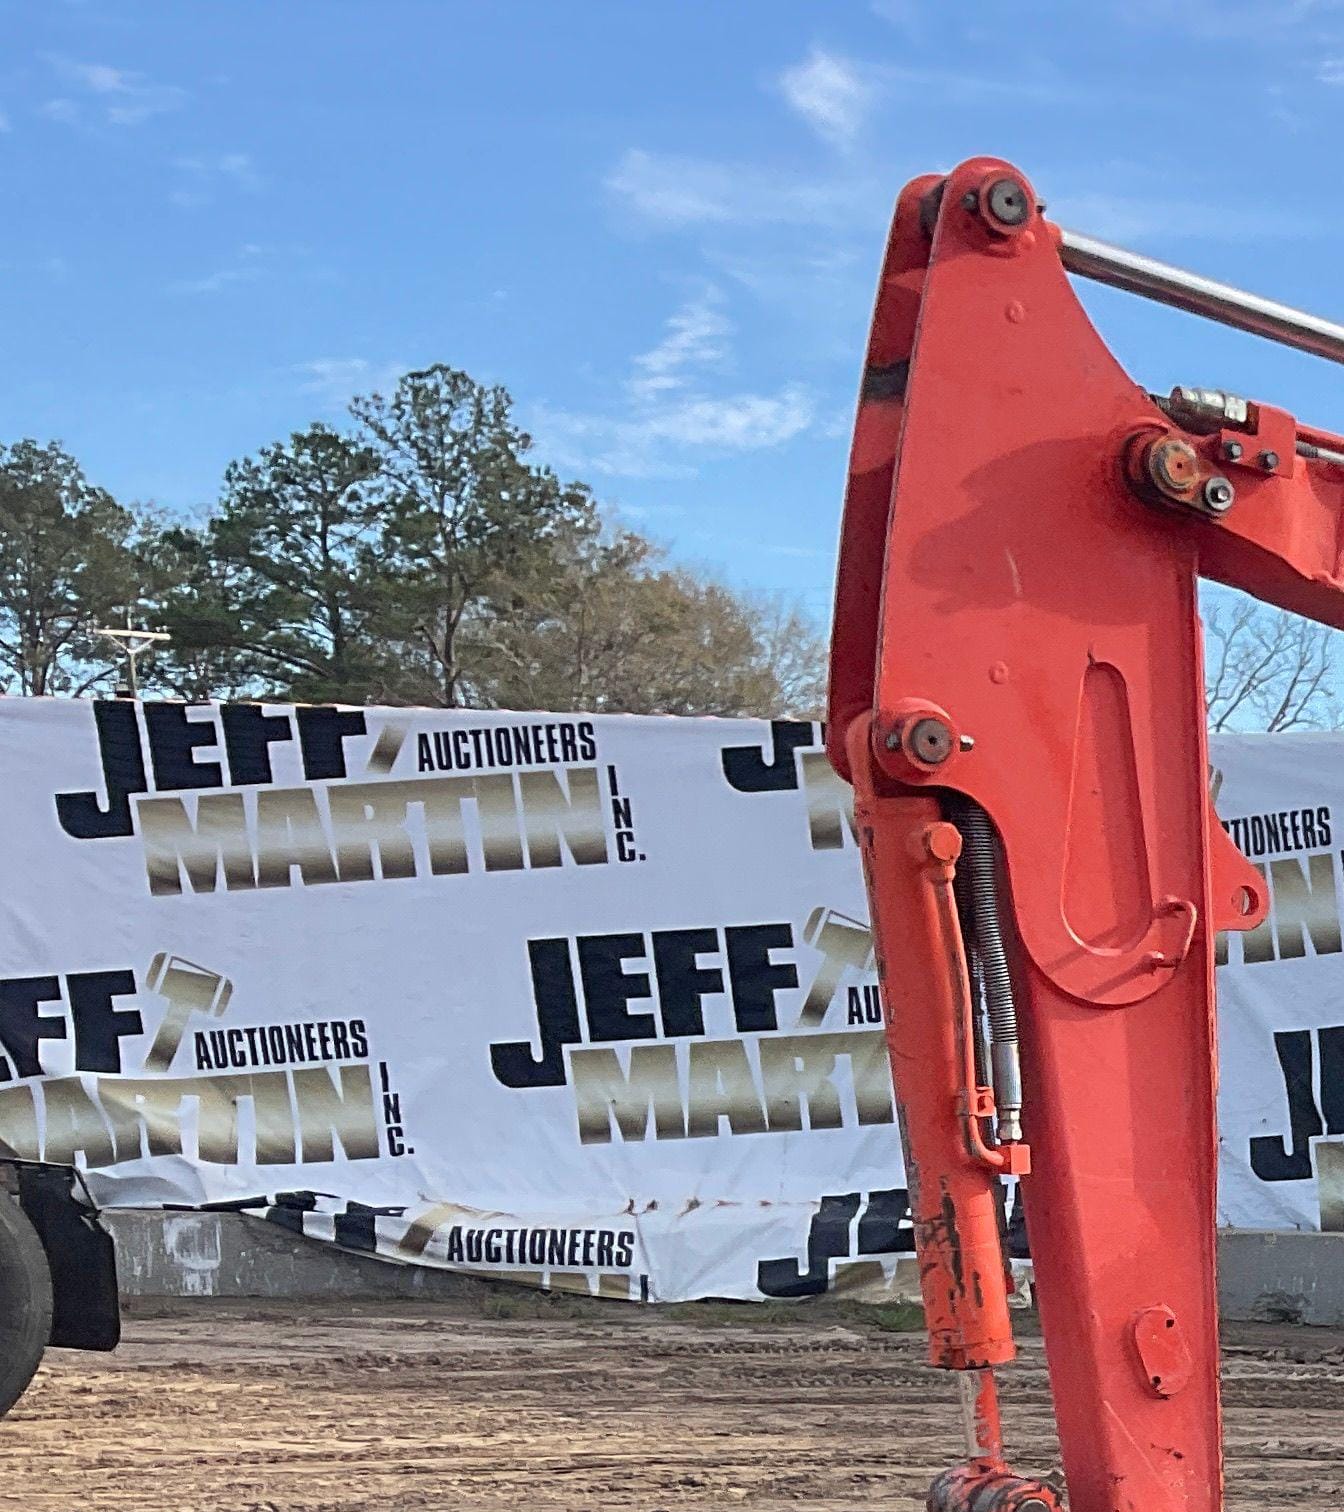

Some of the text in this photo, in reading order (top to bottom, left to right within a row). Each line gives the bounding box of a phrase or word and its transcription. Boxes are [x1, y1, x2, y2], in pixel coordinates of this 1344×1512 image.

[55, 699, 367, 840] JEFF
[417, 721, 598, 773] AUCTIONEERS
[137, 767, 609, 897] MARTIN
[1222, 806, 1332, 857] TIONEERS
[0, 969, 144, 1082] FF
[195, 1020, 370, 1070] AUCTIONEERS
[489, 923, 801, 1089] JEFF
[568, 1030, 895, 1146] MART
[448, 1226, 635, 1268] AUCTIONEERS
